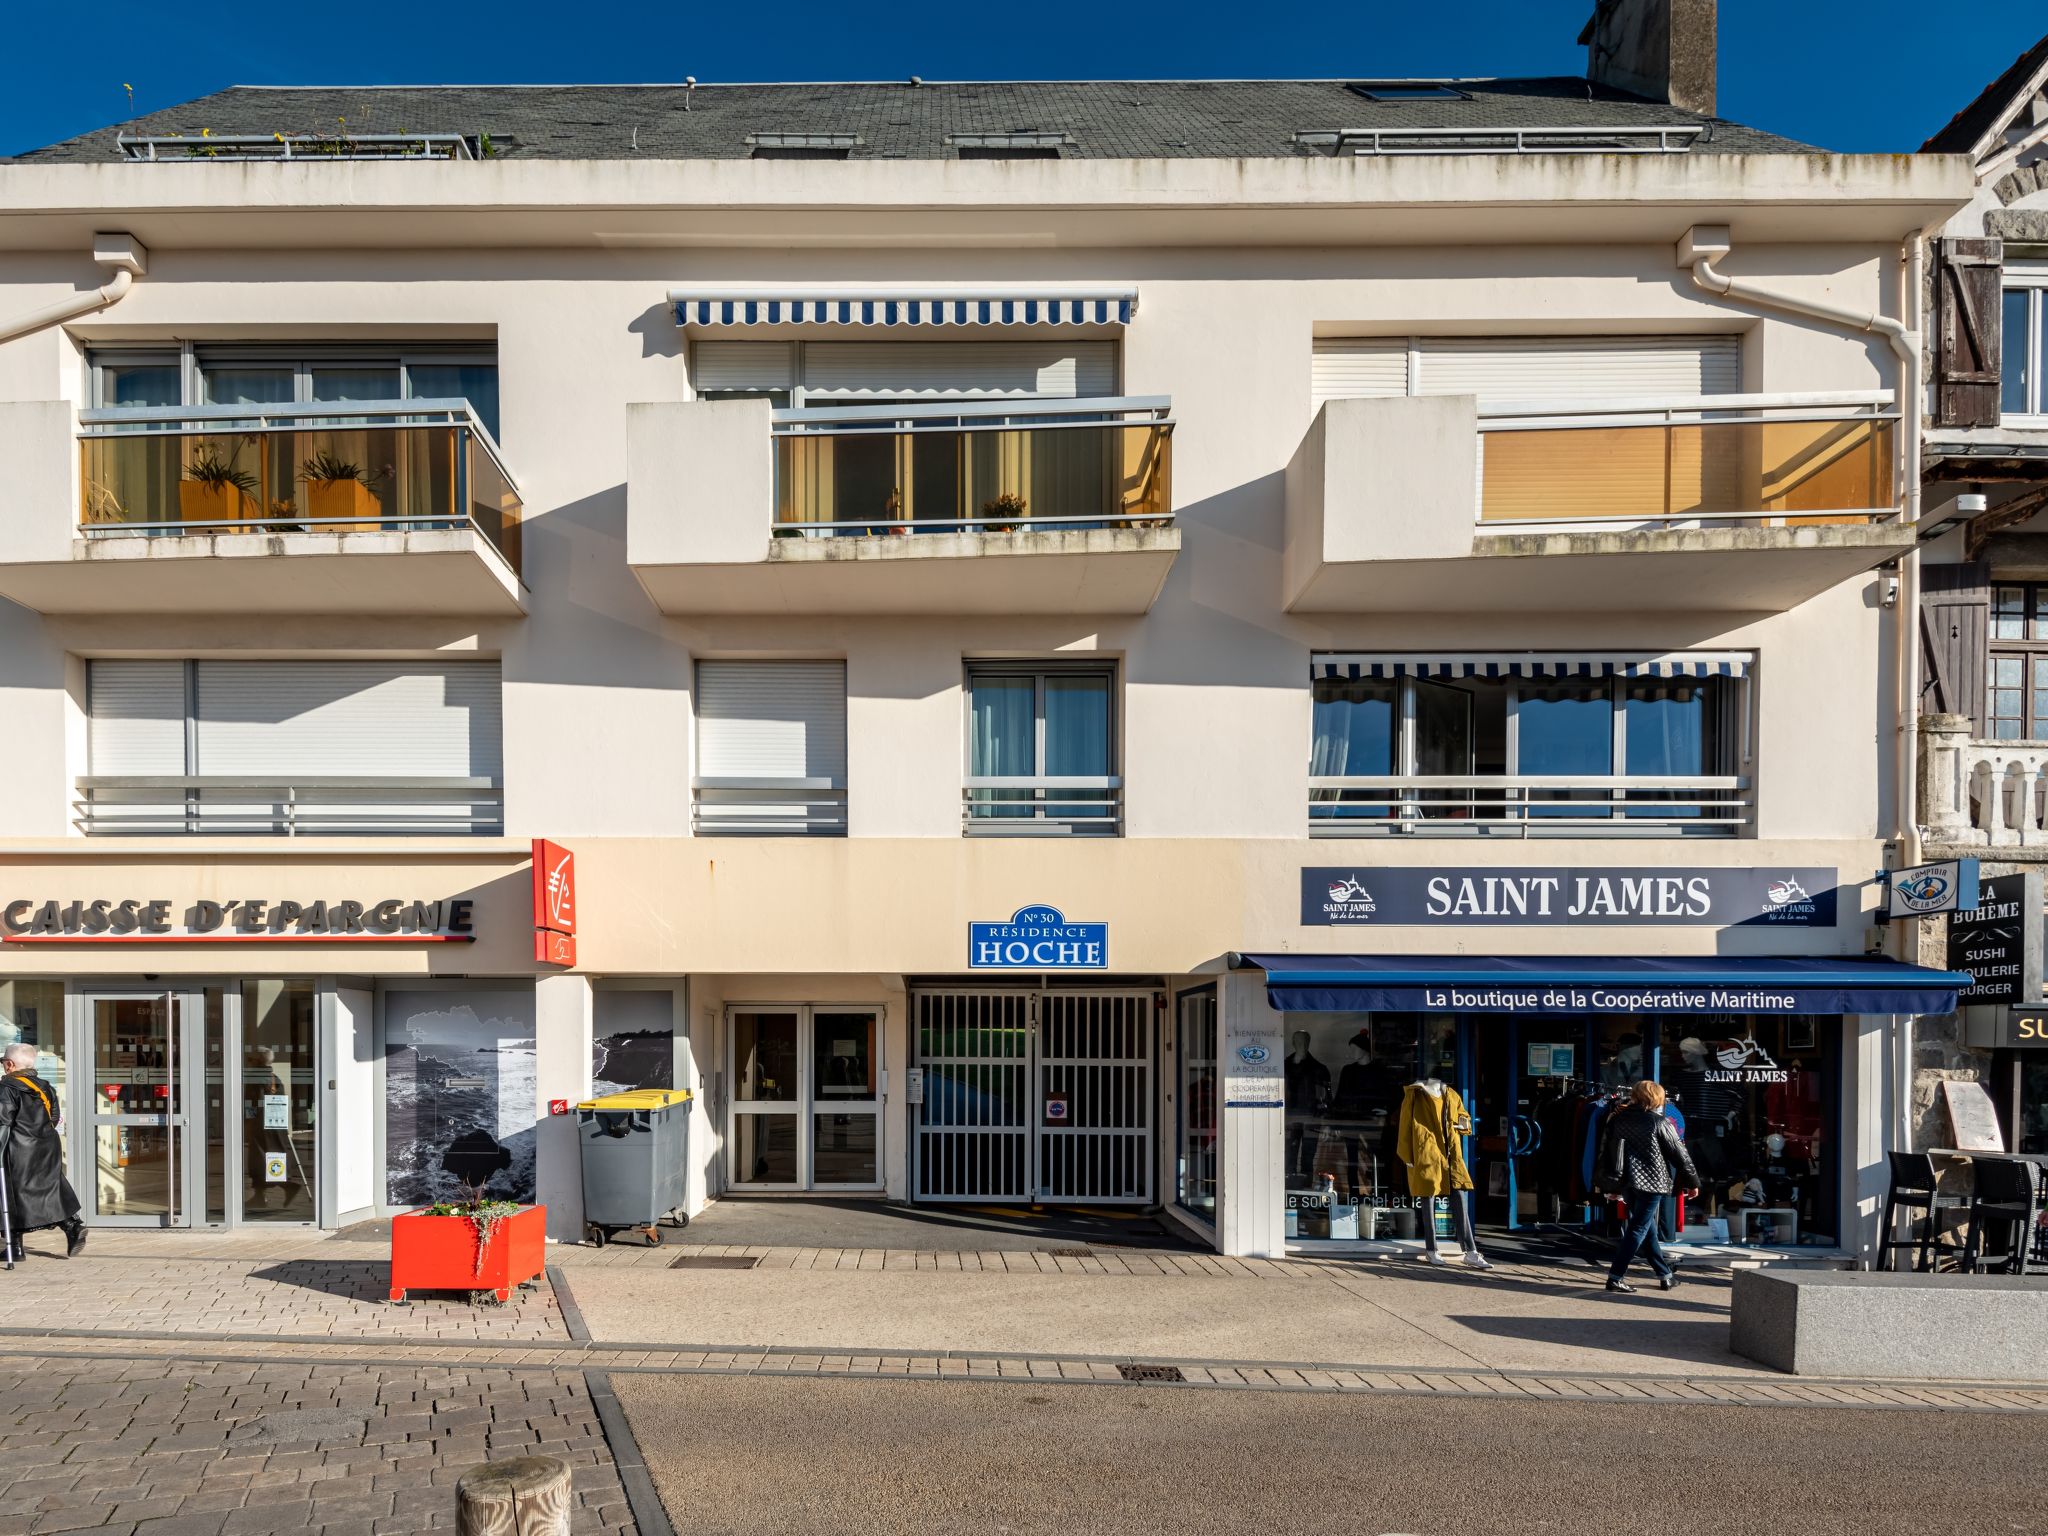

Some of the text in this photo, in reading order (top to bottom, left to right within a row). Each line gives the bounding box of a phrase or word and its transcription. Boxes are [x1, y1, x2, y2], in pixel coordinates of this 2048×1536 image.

[1910, 868, 1948, 881] COMPTOIR
[1426, 877, 1711, 916] SAINT JAMES
[1911, 894, 1948, 909] DE LA MER
[1323, 903, 1376, 912] SAINT JAMES
[1762, 904, 1816, 913] SAINT JAMES
[4, 899, 474, 933] CAISSE D'EPARGNE
[1041, 913, 1055, 923] 30
[989, 926, 1087, 937] RÉSIDENCE
[977, 940, 1100, 965] HOCHE
[1965, 947, 2006, 961] SUSHI
[1958, 983, 2012, 996] BURGER
[1426, 990, 1795, 1011] La boutique de la Coopérative Maritime
[1234, 1030, 1277, 1038] BIENVENUE
[1243, 1066, 1279, 1074] BOUTIQUE
[1704, 1070, 1788, 1083] SAINT JAMES
[1285, 1194, 1297, 1208] le
[1392, 1195, 1407, 1209] et
